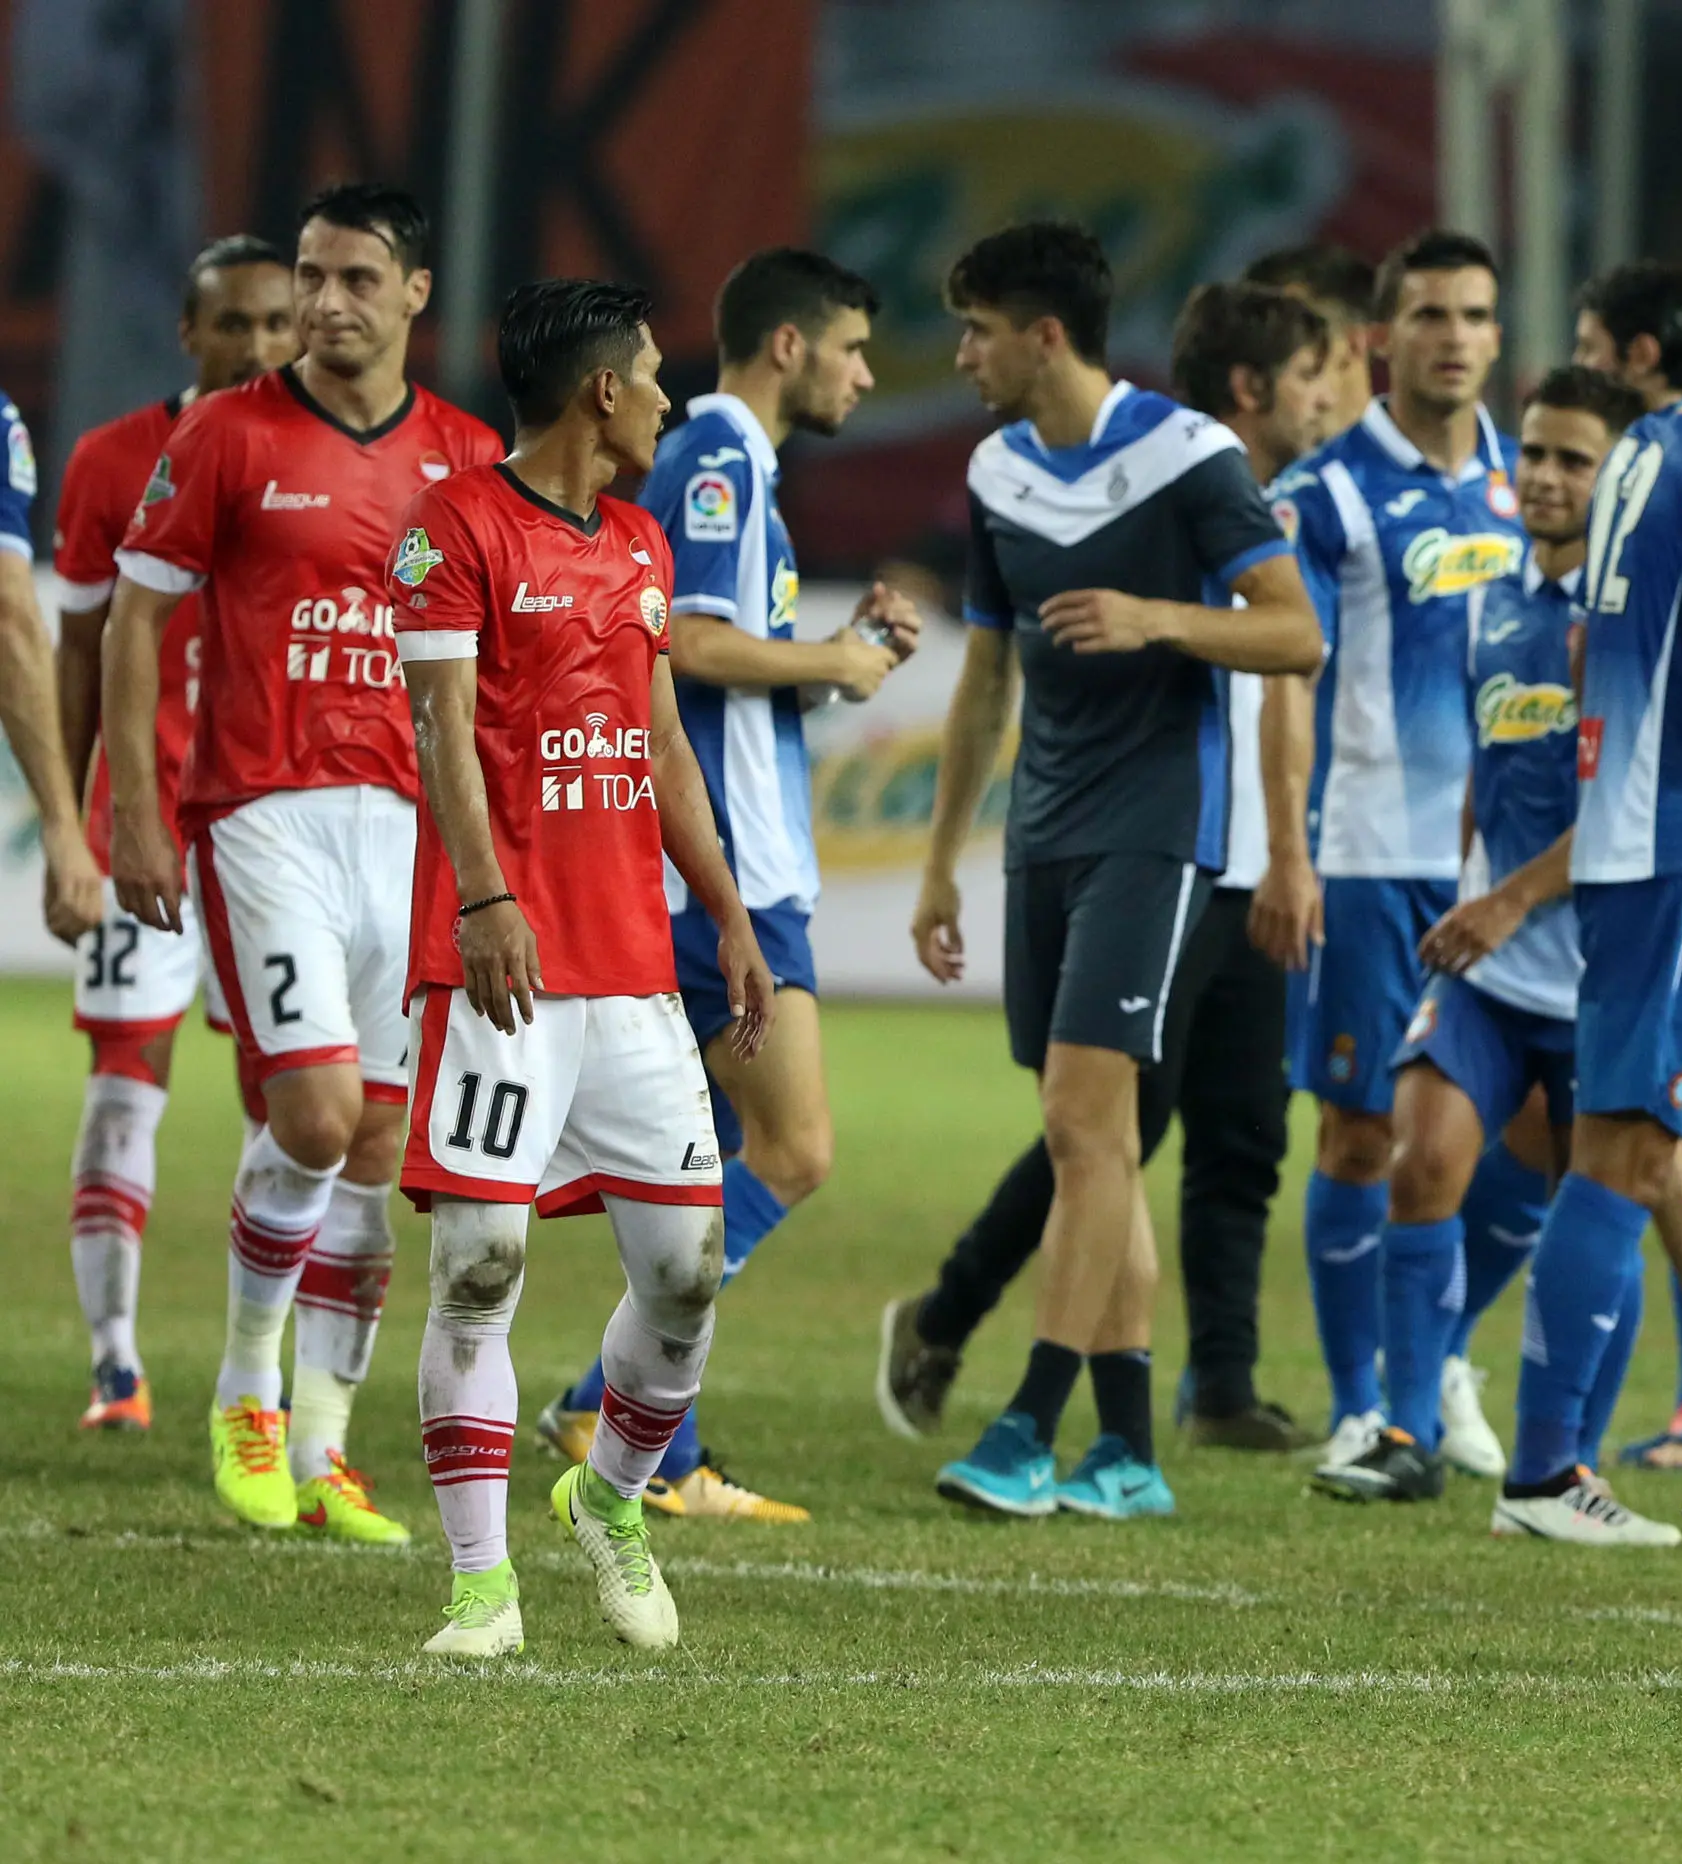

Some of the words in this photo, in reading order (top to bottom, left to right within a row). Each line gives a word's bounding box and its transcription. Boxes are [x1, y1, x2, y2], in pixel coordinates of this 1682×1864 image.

[510, 582, 574, 614] League
[592, 773, 658, 812] TOA
[263, 953, 304, 1026] 2
[445, 1070, 530, 1161] 10
